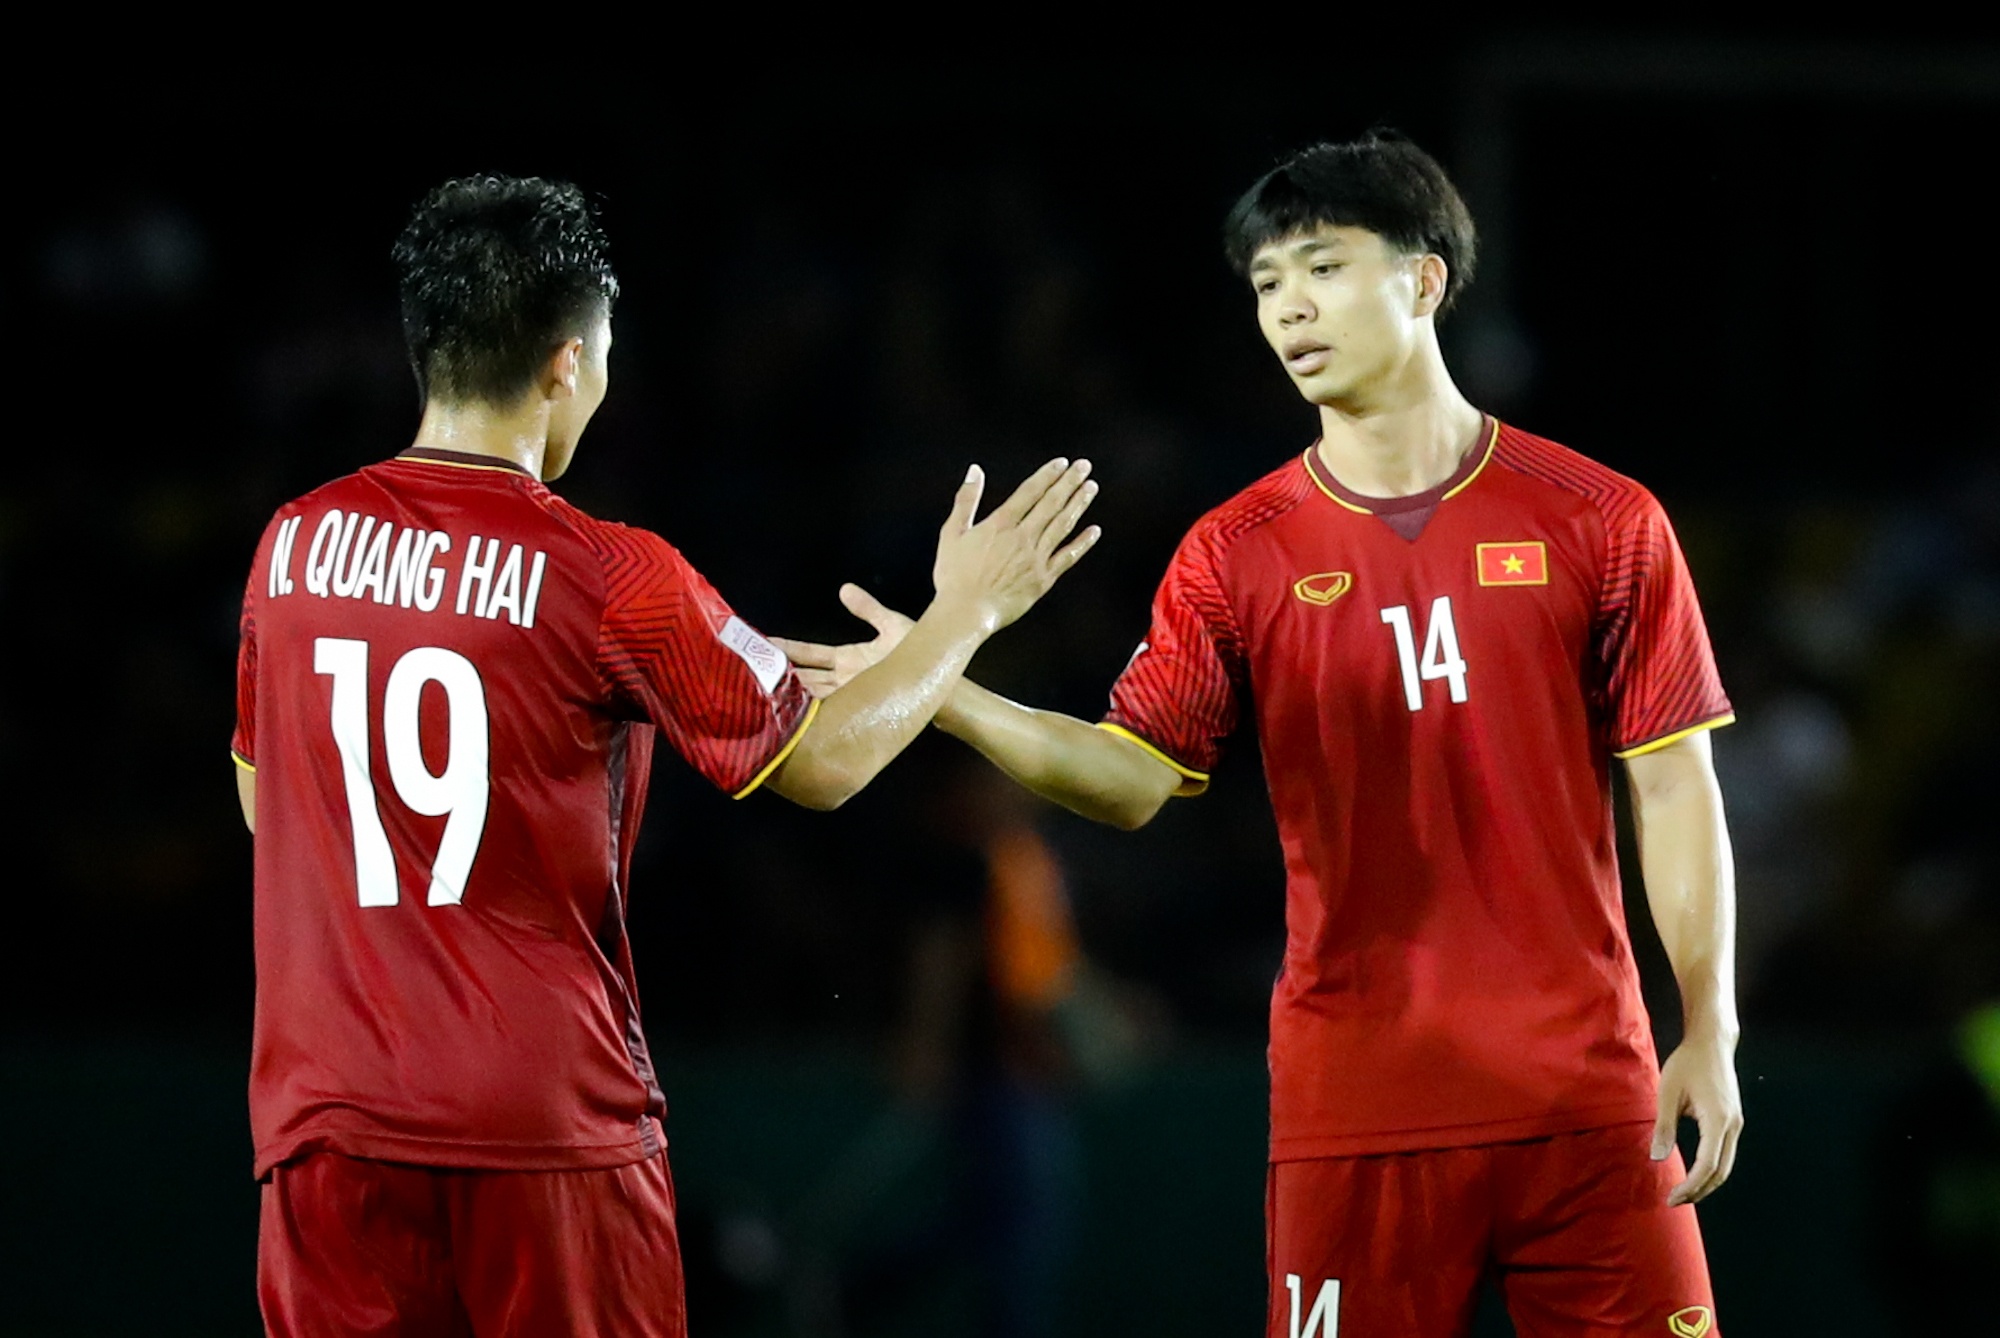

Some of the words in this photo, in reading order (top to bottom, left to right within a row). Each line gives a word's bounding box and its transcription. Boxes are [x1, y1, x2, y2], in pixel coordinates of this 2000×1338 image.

[268, 515, 302, 599] N.
[304, 508, 451, 613] QUANG
[455, 535, 547, 629] HAI
[1380, 595, 1468, 712] 14
[313, 636, 490, 908] 19
